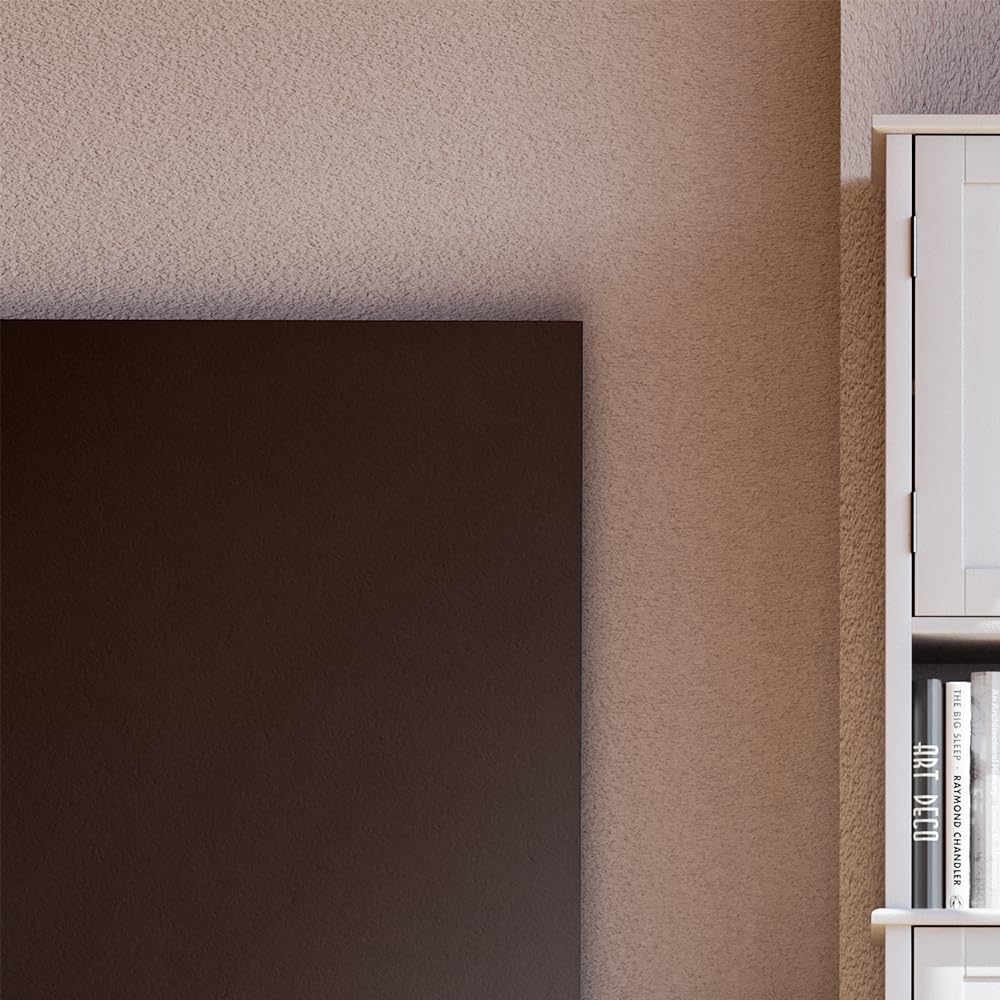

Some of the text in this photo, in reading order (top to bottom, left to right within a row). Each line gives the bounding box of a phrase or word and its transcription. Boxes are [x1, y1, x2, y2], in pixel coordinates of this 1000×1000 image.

[912, 742, 939, 842] ART DECO
[953, 689, 962, 886] THE BIG SLEEP RAYMOND CHANDLER
